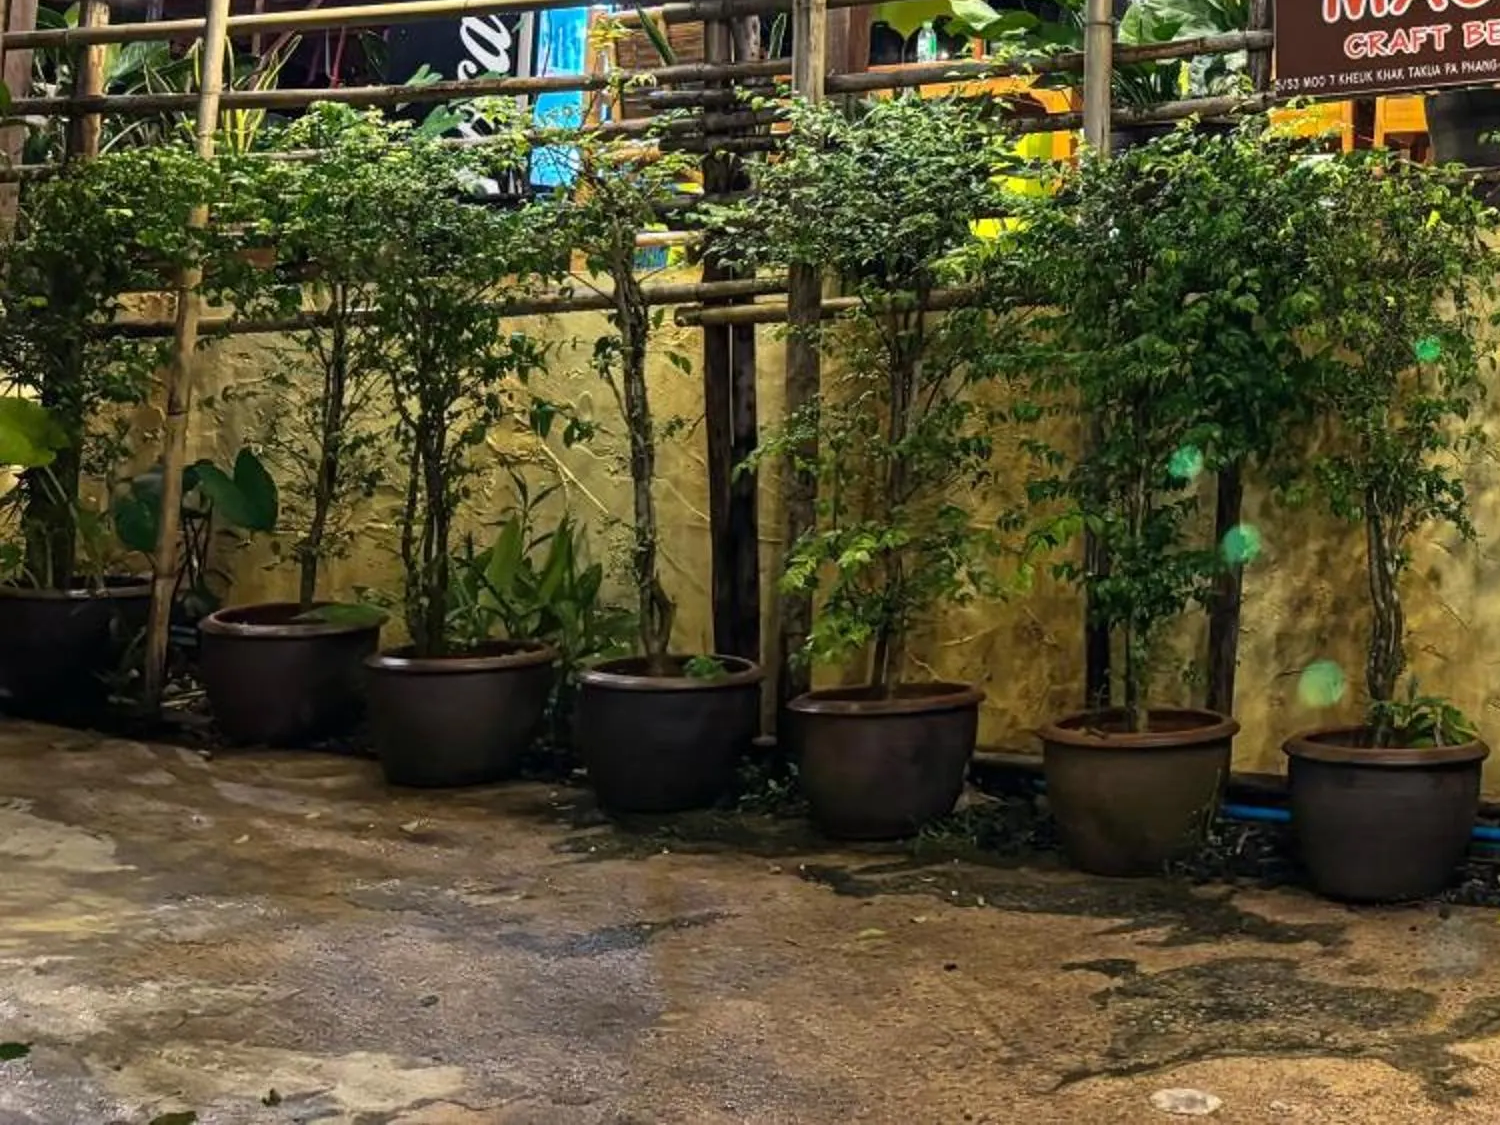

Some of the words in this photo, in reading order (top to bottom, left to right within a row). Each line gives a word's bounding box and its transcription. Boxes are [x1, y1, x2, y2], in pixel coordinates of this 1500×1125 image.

[1343, 23, 1453, 60] CRAFT
[1303, 75, 1326, 88] MOO
[1408, 64, 1441, 78] TAKUA
[1445, 62, 1458, 75] PA
